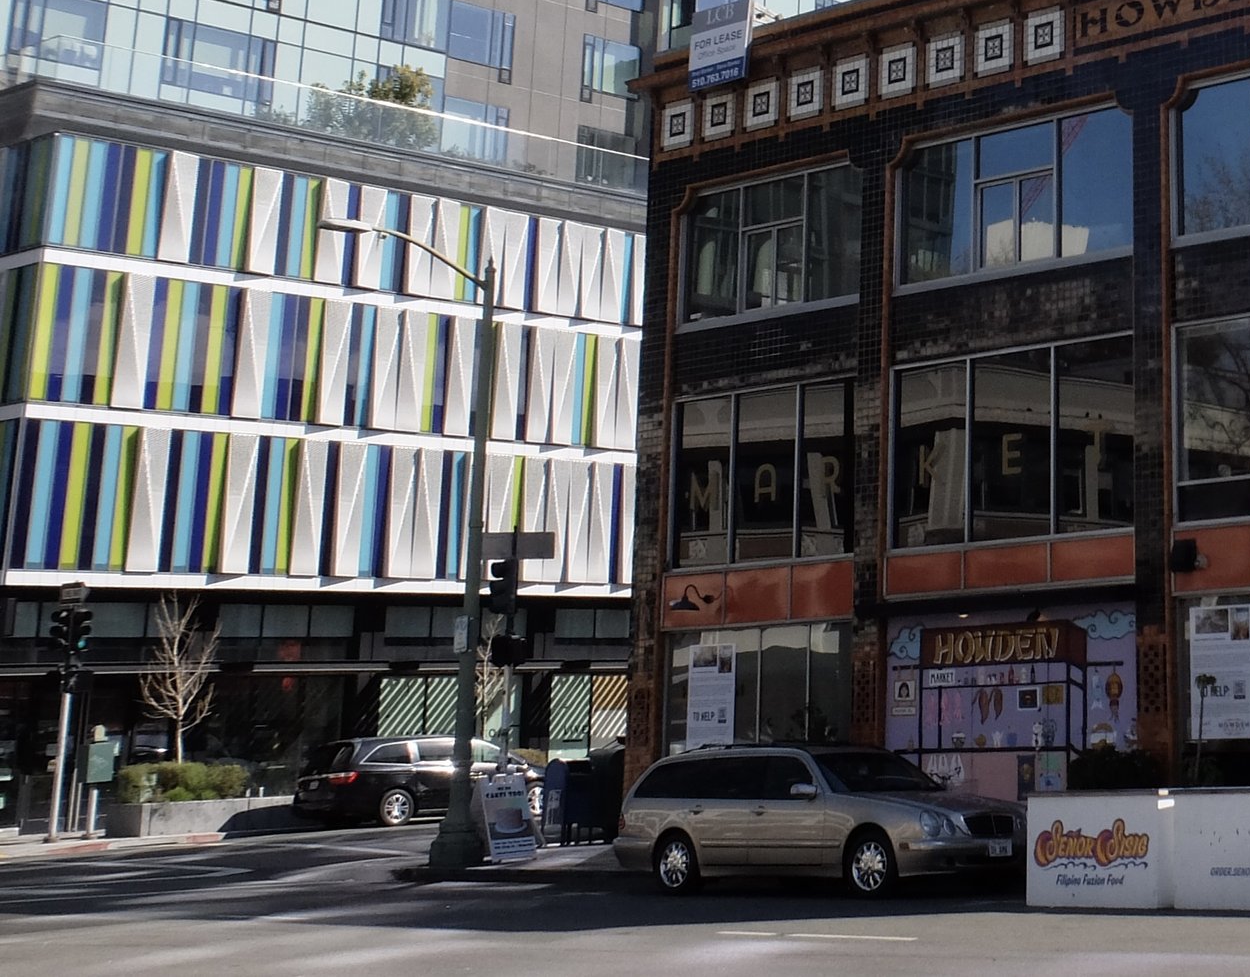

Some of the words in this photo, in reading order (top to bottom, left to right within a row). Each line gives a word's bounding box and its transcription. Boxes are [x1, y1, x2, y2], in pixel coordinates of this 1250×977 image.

[706, 4, 735, 25] LCB
[694, 38, 712, 51] FOR
[714, 29, 742, 45] LEASE
[691, 67, 739, 88] 510.763.7016
[933, 628, 1059, 665] HOWDEN
[930, 672, 954, 684] MARKET
[701, 711, 715, 721] HELP
[1095, 819, 1149, 867] SISIG
[1056, 874, 1081, 887] Filipino
[1106, 874, 1124, 886] Food
